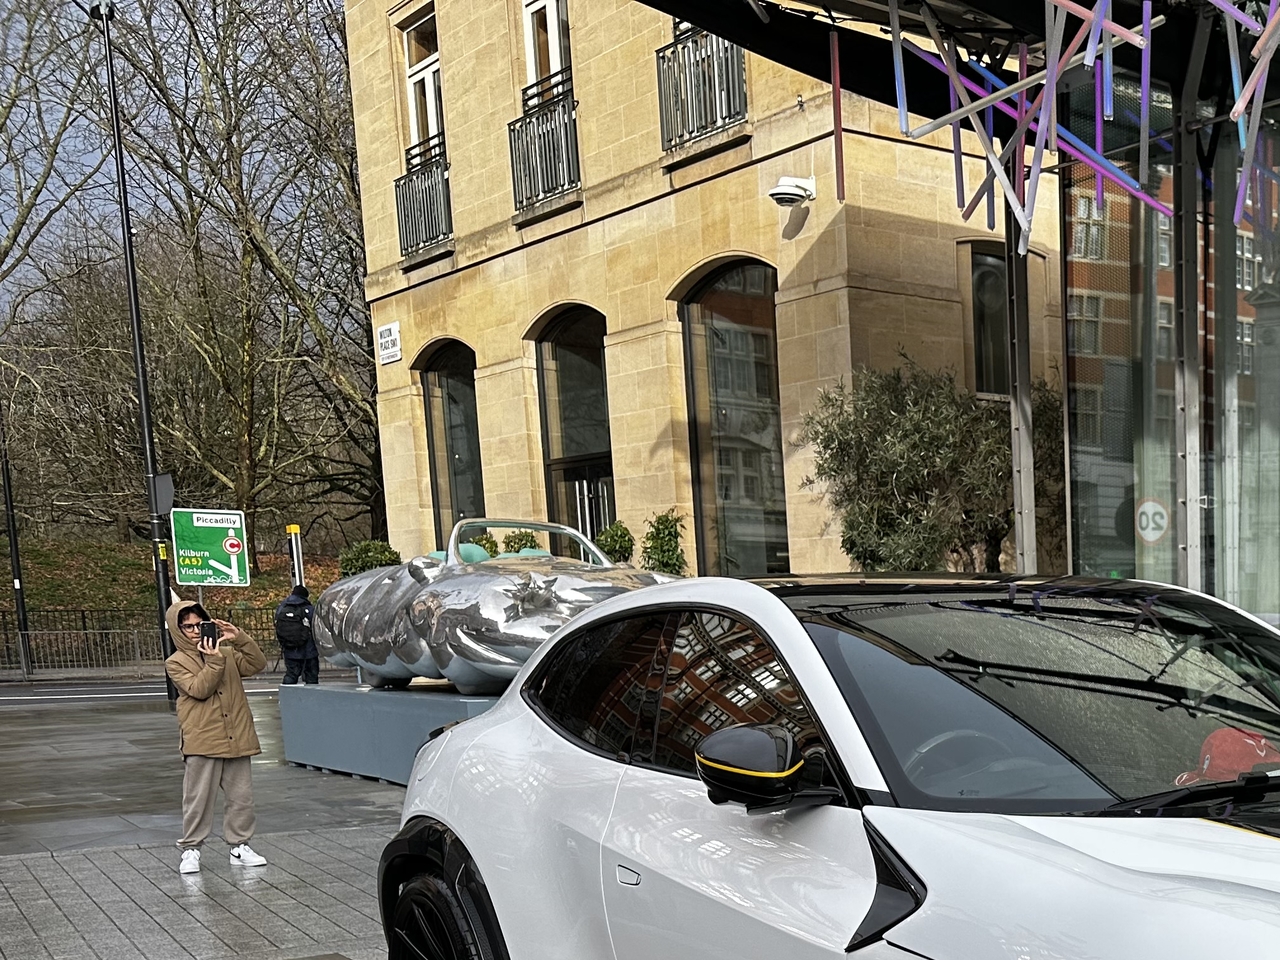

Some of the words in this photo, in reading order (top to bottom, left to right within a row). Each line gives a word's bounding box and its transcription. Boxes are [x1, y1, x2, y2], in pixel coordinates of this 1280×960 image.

[196, 516, 237, 526] Piccadilly
[179, 549, 210, 557] Kilburn
[179, 557, 202, 566] (A5)
[180, 567, 213, 575] Victoria
